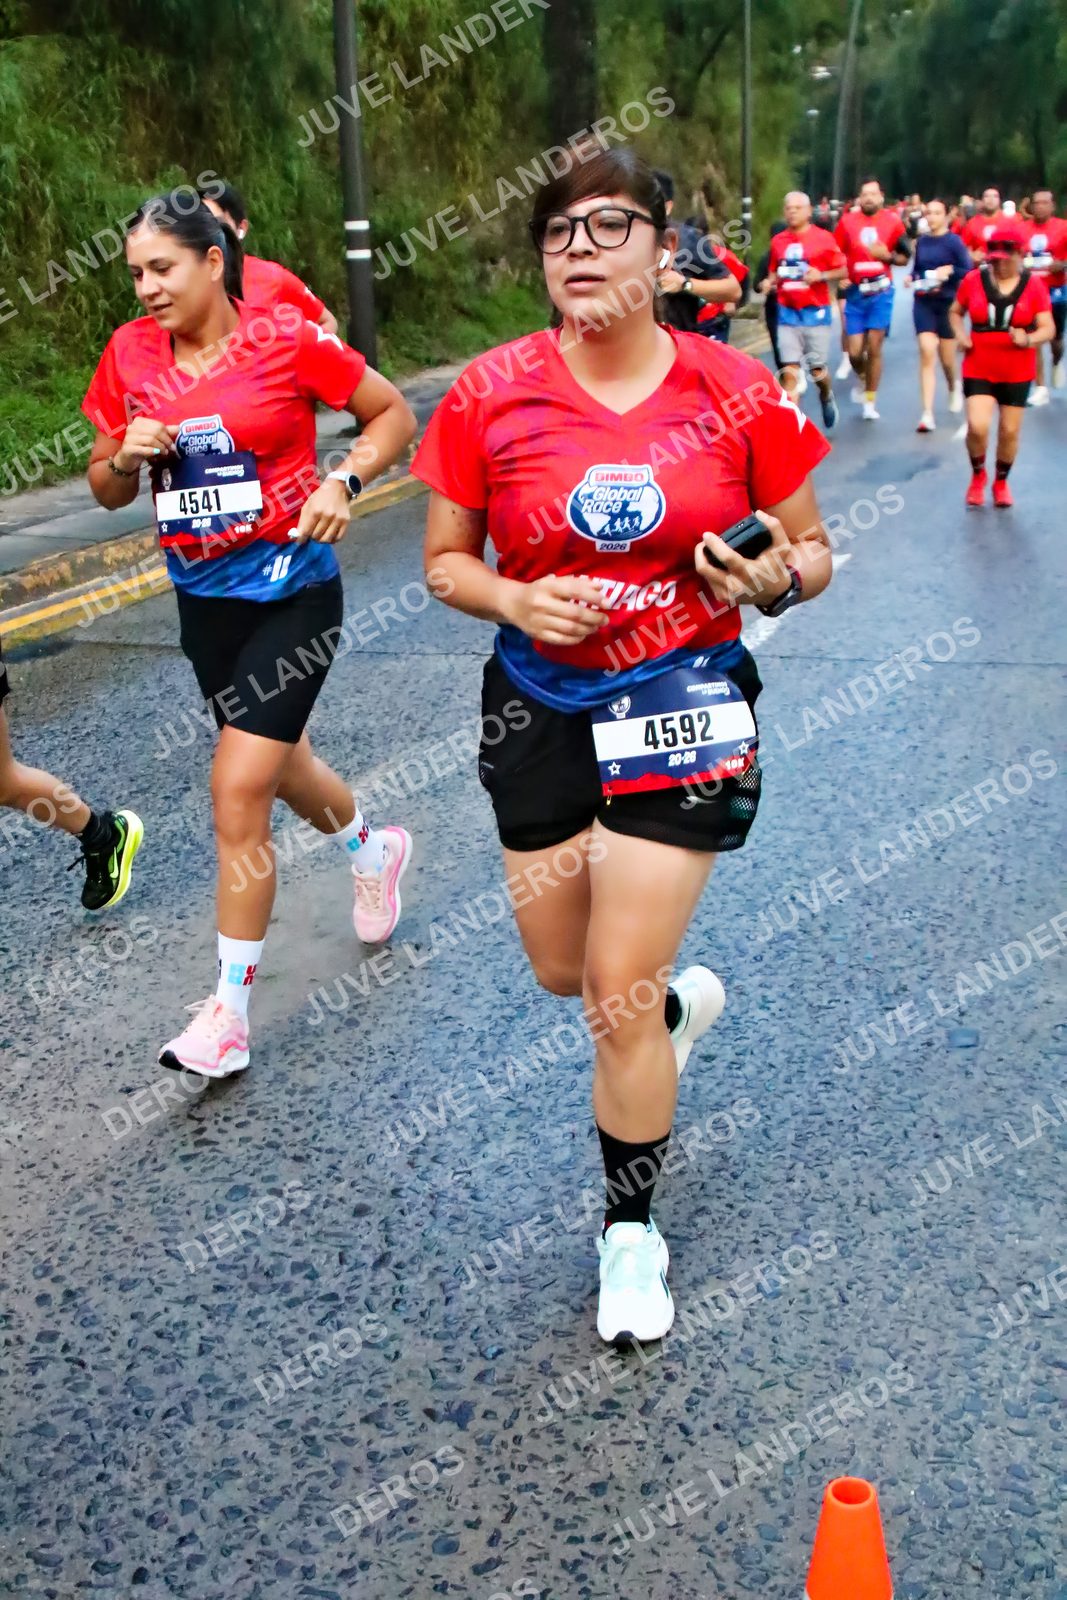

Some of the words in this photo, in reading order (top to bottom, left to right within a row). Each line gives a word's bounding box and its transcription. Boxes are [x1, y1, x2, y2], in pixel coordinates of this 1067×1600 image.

[185, 421, 216, 433] BIMBO
[187, 433, 218, 446] Global
[595, 472, 644, 482] BIMBO
[592, 487, 643, 502] Global
[179, 488, 221, 516] 4541
[582, 499, 623, 514] Race
[600, 542, 627, 551] 2026
[644, 710, 714, 750] 4592
